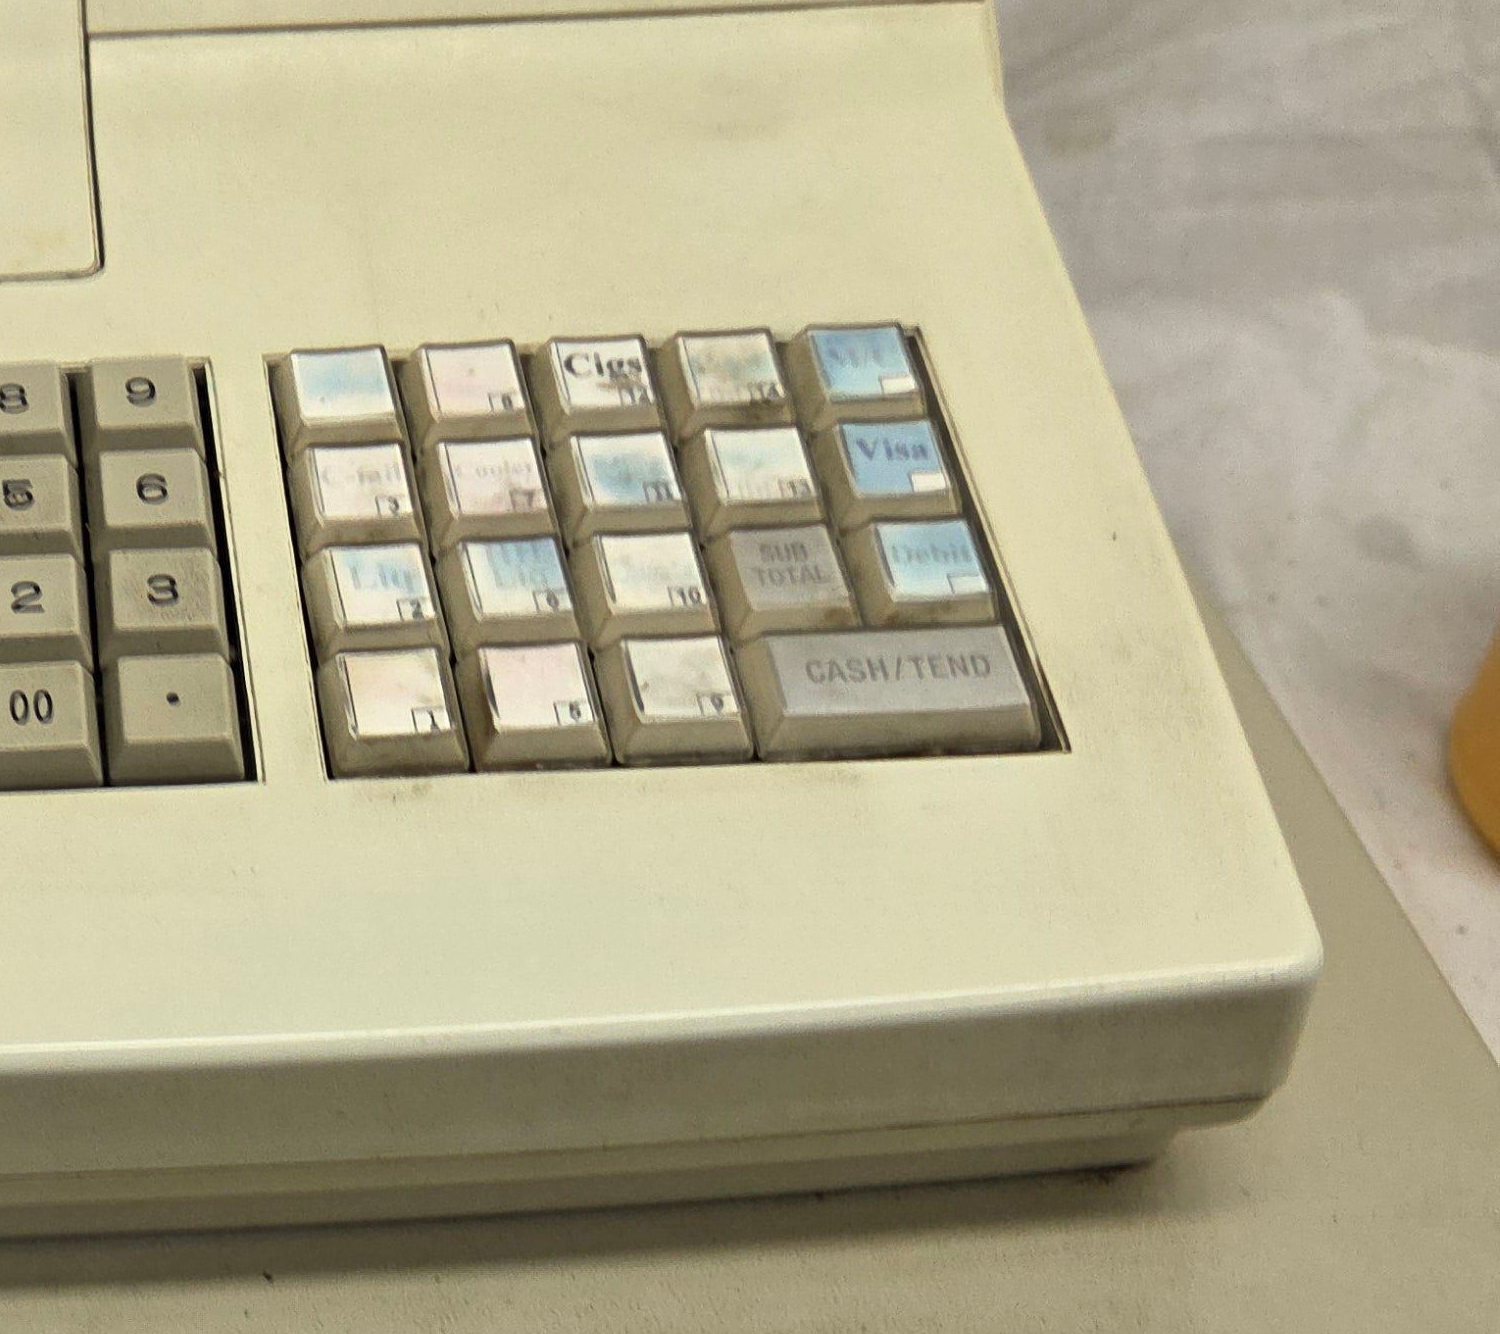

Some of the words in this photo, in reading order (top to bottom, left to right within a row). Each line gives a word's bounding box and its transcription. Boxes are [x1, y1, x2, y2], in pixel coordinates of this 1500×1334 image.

[124, 376, 157, 408] 9
[855, 436, 930, 463] Visa
[1, 478, 35, 512] 5
[135, 472, 169, 505] 6
[146, 573, 180, 608] 3
[754, 564, 828, 588] TOTAL
[9, 579, 46, 614] 2
[805, 652, 992, 686] CASH/TEND
[8, 688, 54, 726] 00
